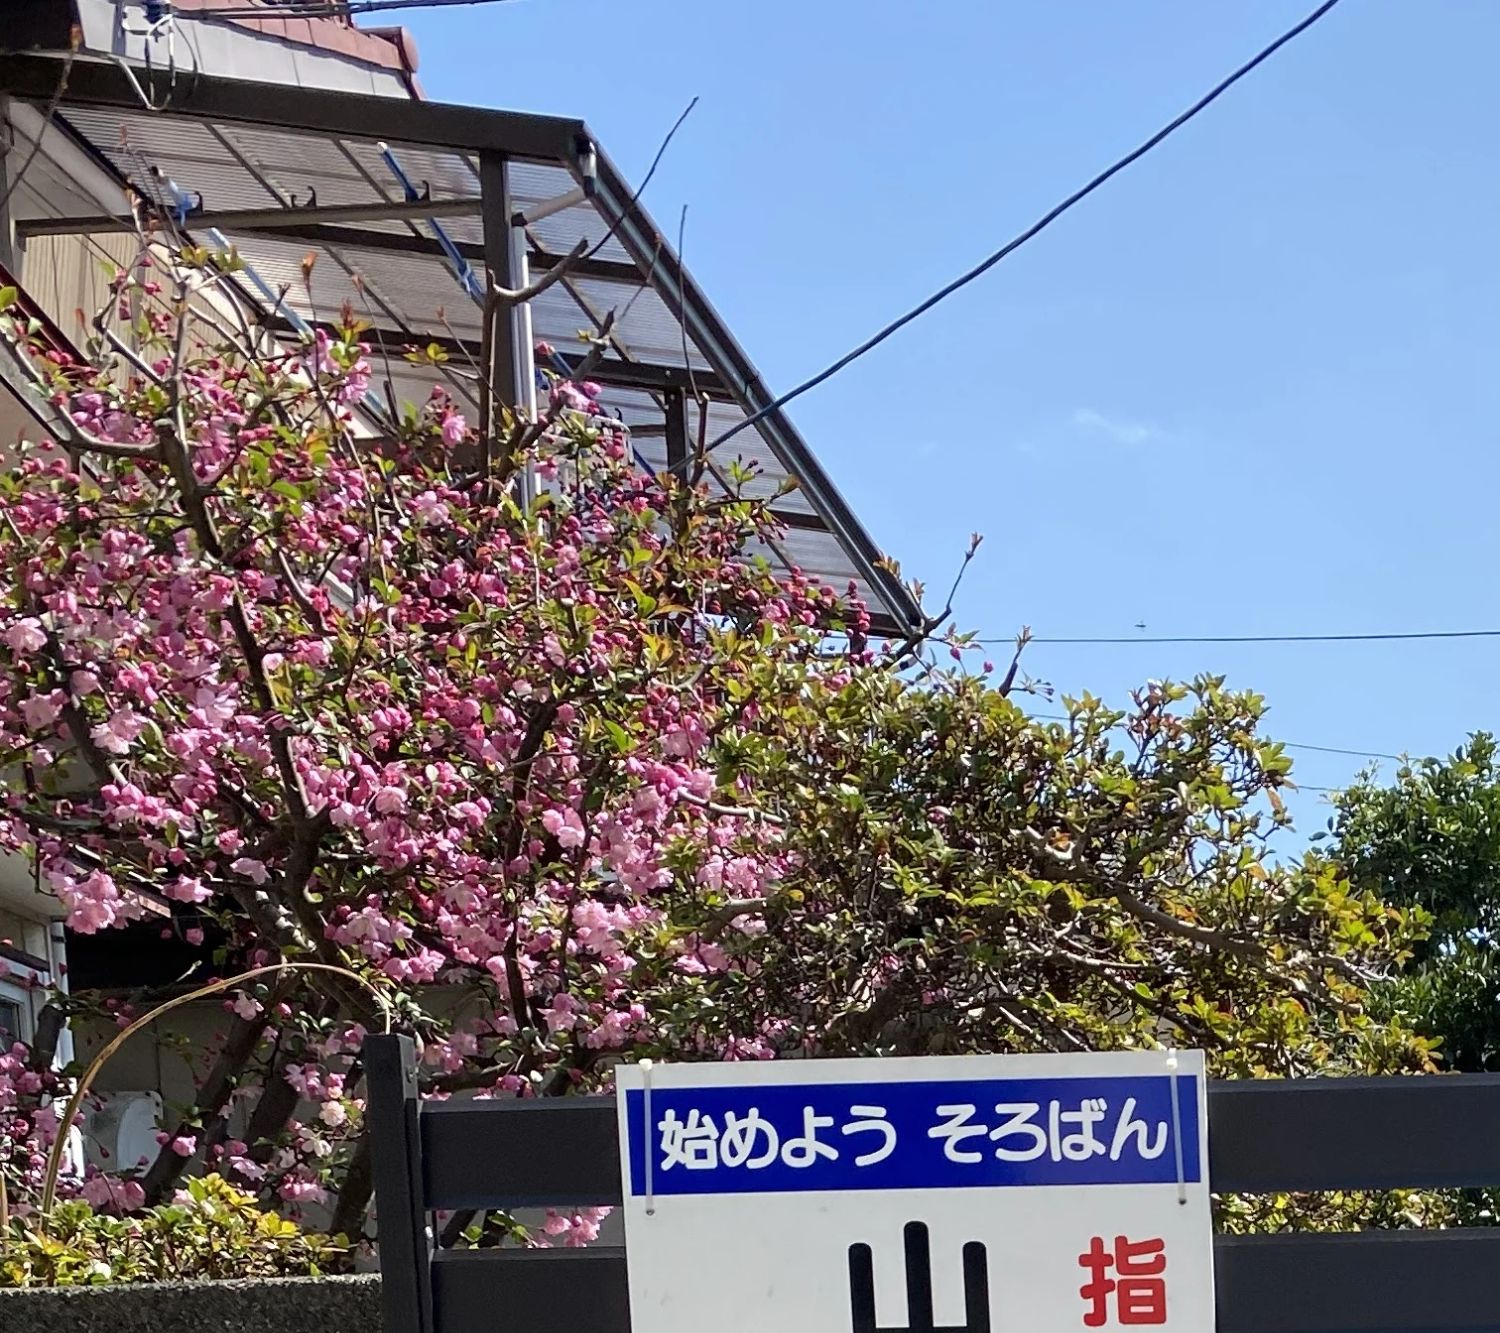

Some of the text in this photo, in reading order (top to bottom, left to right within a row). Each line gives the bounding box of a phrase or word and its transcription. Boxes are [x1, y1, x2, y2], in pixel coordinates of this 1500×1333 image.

[657, 1097, 1168, 1171] 始めよう そろばん
